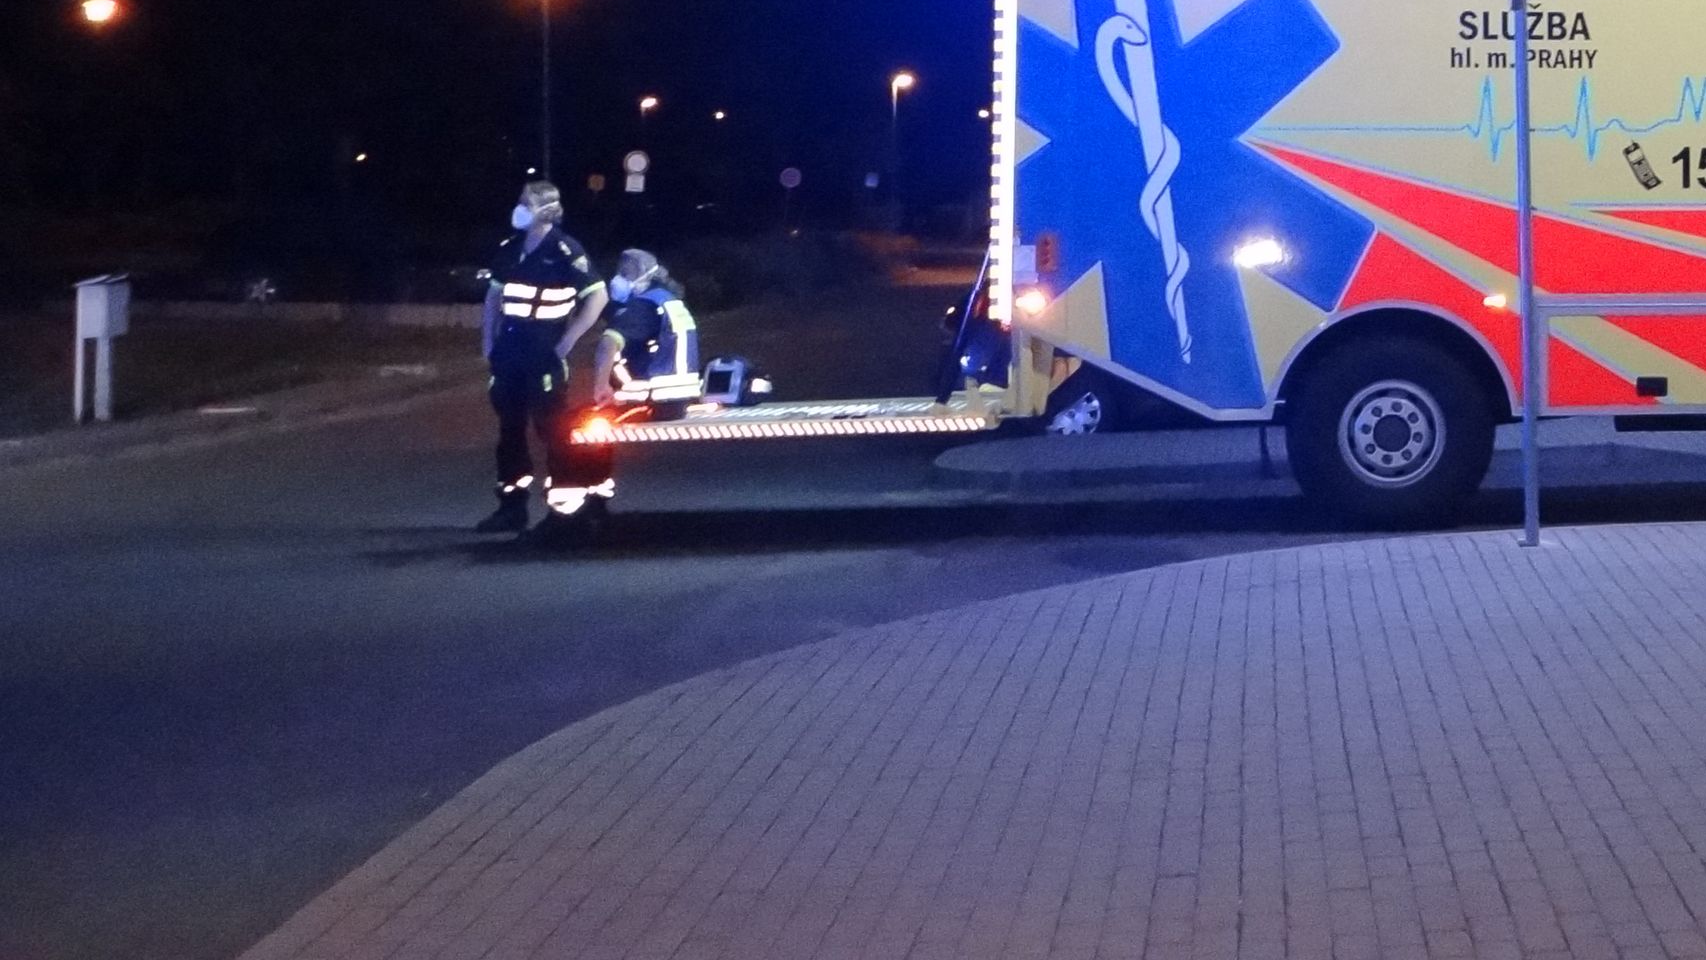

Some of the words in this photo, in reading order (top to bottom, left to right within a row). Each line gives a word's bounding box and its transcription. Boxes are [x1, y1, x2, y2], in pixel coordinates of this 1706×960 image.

[1458, 3, 1591, 41] SLUŽBA
[1450, 47, 1480, 68] hl.
[1487, 52, 1516, 68] m.
[1525, 49, 1598, 69] PRAHY
